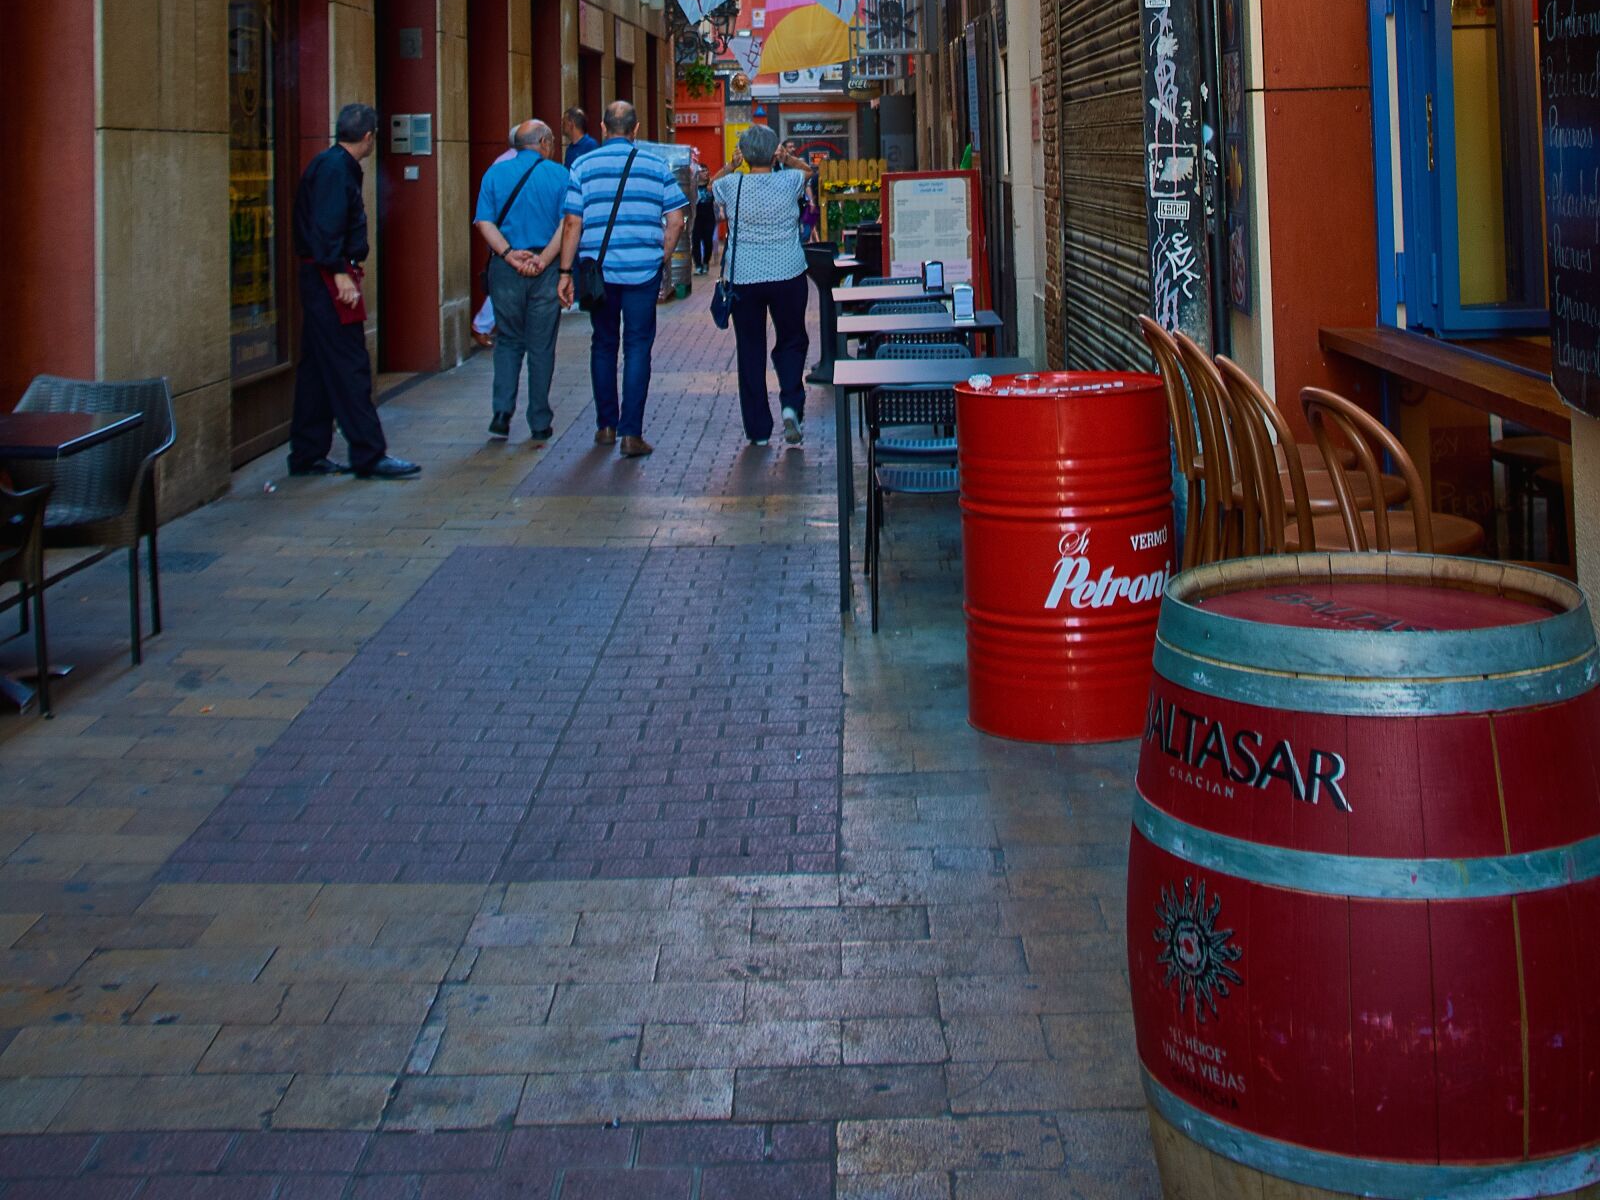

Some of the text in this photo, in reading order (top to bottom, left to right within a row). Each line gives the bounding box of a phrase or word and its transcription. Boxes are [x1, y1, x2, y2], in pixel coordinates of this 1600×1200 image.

[1130, 524, 1168, 552] VERMÚ
[1044, 556, 1171, 609] Petroni
[1169, 765, 1234, 799] GRACIAN
[1199, 1062, 1246, 1095] VIEJAS
